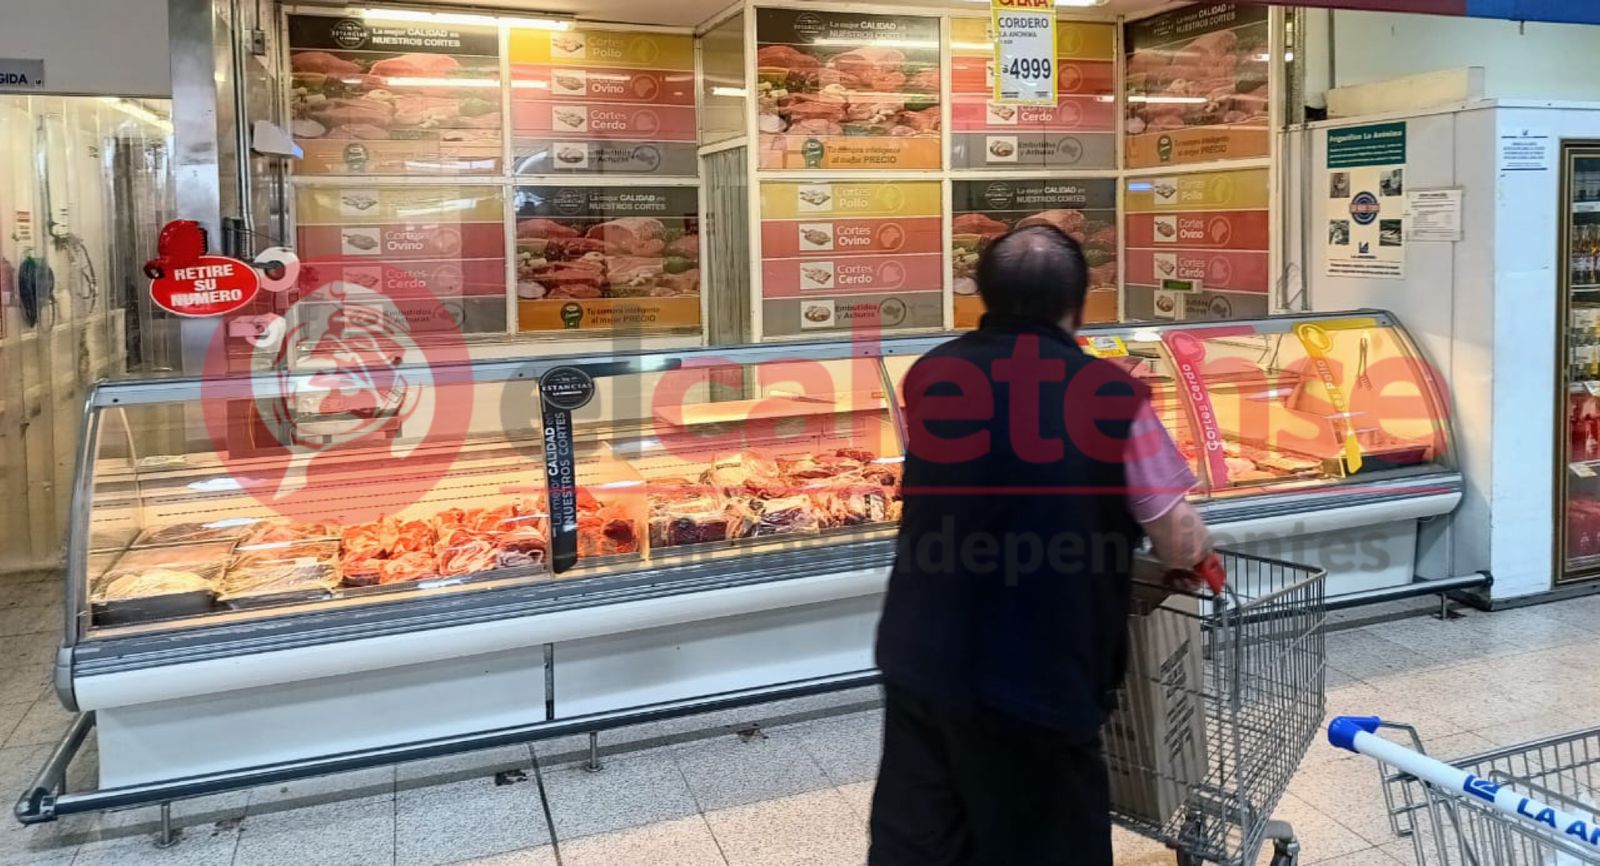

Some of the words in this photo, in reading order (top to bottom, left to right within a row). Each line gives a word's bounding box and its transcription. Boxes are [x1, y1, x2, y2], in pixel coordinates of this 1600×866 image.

[860, 21, 896, 30] CALIDAD
[998, 17, 1049, 28] CORDERO
[372, 27, 382, 35] La
[407, 28, 448, 37] CALIDAD
[372, 37, 422, 46] NUESTROS
[424, 38, 460, 47] CORTES
[593, 48, 622, 58] Pollo
[591, 84, 624, 94] Ovino
[590, 110, 627, 120] Cortes
[1020, 112, 1053, 121] Cerdo
[591, 120, 626, 130] Cerdo
[1044, 186, 1077, 194] CALIDAD
[619, 194, 656, 202] CALIDAD
[839, 198, 868, 208] Pollo
[1179, 218, 1204, 229] Cortes
[836, 225, 872, 236] Cortes
[1180, 230, 1204, 239] Ovino
[387, 241, 424, 251] Ovino
[838, 236, 871, 246] Ovino
[173, 263, 235, 281] RETIRE
[836, 264, 873, 275] Cortes
[1179, 268, 1204, 278] Cerdo
[387, 279, 427, 289] Cerdo
[838, 274, 873, 284] Cerdo
[193, 279, 217, 292] SU
[623, 315, 656, 323] PRECIO
[542, 382, 592, 392] ESTANCIAS
[1182, 364, 1203, 402] Cerdo
[1199, 403, 1219, 452] Cortes
[555, 411, 569, 457] CORTES
[545, 427, 558, 476] CALIDAD
[560, 459, 576, 532] NUESTROS
[1517, 797, 1557, 829] LA
